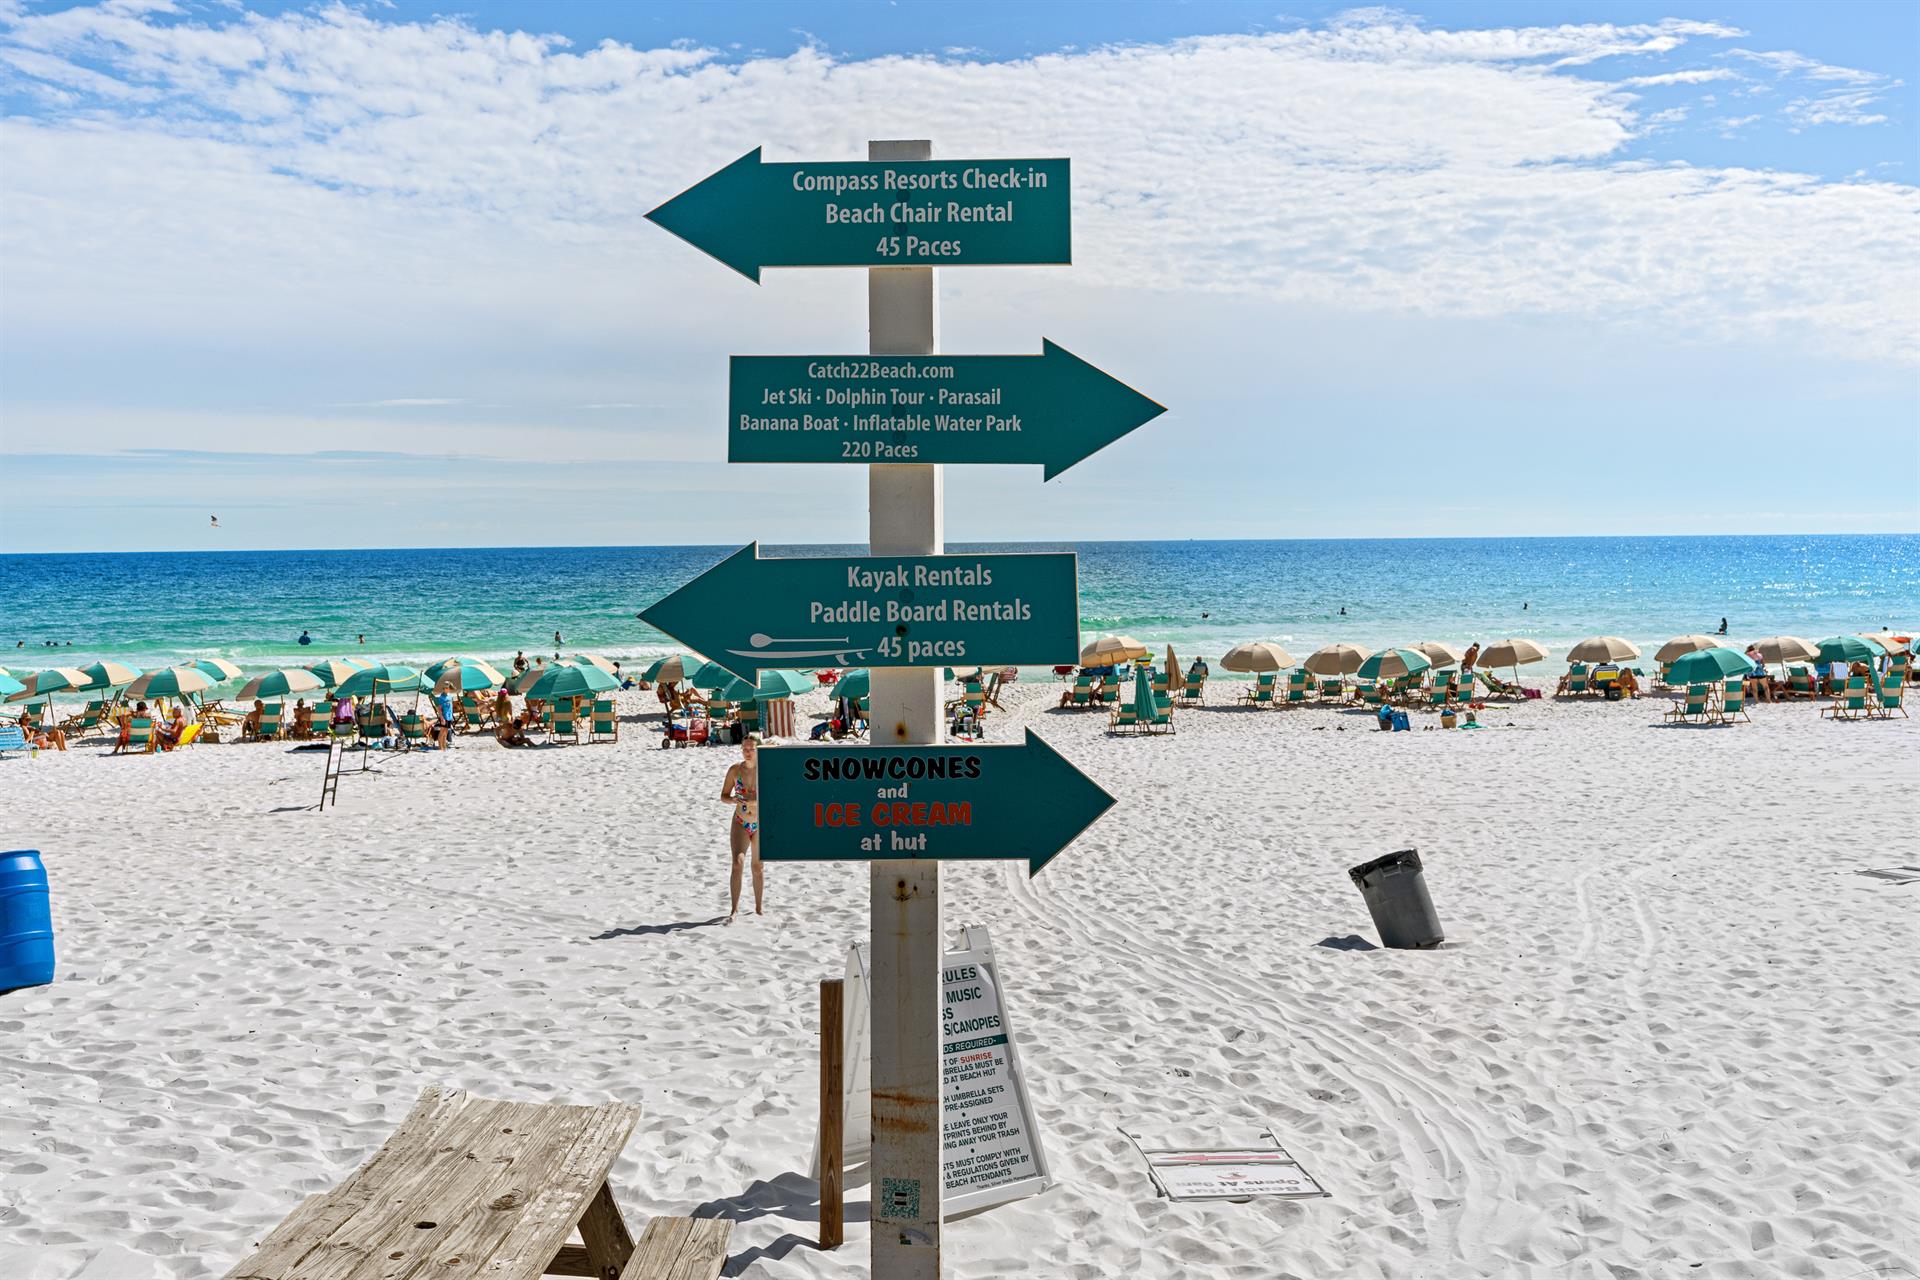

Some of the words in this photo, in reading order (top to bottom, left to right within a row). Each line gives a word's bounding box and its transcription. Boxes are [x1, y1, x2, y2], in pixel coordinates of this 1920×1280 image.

[792, 170, 879, 196] Compass
[884, 169, 958, 190] Resorts
[962, 167, 1047, 189] Check-in
[826, 202, 884, 224] Beach
[890, 201, 942, 223] Chair
[947, 200, 1013, 222] Rental
[876, 237, 900, 257] 45
[906, 236, 961, 256] Paces
[808, 362, 954, 379] Catch22Beach.com
[761, 389, 785, 405] Jet
[789, 388, 812, 405] Ski
[826, 388, 886, 408] Dolphin
[891, 388, 925, 405] Tour
[938, 388, 1001, 405] Parasail
[740, 415, 799, 431] Banana
[803, 415, 839, 431] Boat
[853, 414, 930, 431] Inflatable
[935, 414, 982, 431] Water
[986, 414, 1022, 431] Park
[842, 441, 871, 457] 220
[875, 441, 918, 457] Paces
[847, 565, 909, 592] Kayak
[915, 564, 992, 586] Rentals
[810, 601, 880, 623] Paddle
[886, 600, 947, 622] Board
[953, 599, 1031, 621] Rentals
[877, 637, 902, 657] 45
[908, 640, 966, 662] paces
[803, 755, 981, 780] SNOWCONES
[877, 783, 908, 798] and
[815, 803, 860, 827] ICE
[872, 802, 971, 827] CREAM
[860, 835, 882, 851] at
[891, 833, 927, 851] hut
[946, 986, 982, 1004] MUSIC
[943, 1064, 974, 1076] BRELLAS
[974, 1060, 994, 1069] MUST
[994, 1057, 1004, 1066] BE
[948, 1057, 958, 1066] OF
[960, 1051, 993, 1064] SUNRISE
[950, 1075, 958, 1083] AT
[960, 1071, 982, 1081] BEACH
[982, 1068, 996, 1077] HUT
[950, 1088, 986, 1101] UMBRELLA
[987, 1085, 1005, 1095] SETS
[944, 1096, 994, 1112] PRE-ASSIGNED
[950, 1119, 971, 1130] LEAVE
[972, 1115, 989, 1126] ONLY
[989, 1111, 1008, 1122] YOUR
[972, 1123, 997, 1135] BEHIND
[998, 1120, 1007, 1129] BY
[943, 1140, 957, 1151] ING
[958, 1136, 977, 1147] AWAY
[977, 1132, 997, 1142] YOUR
[997, 1127, 1020, 1138] TRASH
[952, 1161, 999, 1178] REGULATIONS
[1000, 1157, 1020, 1168] GIVEN
[1020, 1154, 1030, 1163] BY
[955, 1157, 975, 1168] MUST
[976, 1151, 1002, 1163] COMPLY
[1002, 1147, 1021, 1157] WITH
[945, 1178, 969, 1189] BEACH
[970, 1167, 1012, 1184] ATTENDANTS
